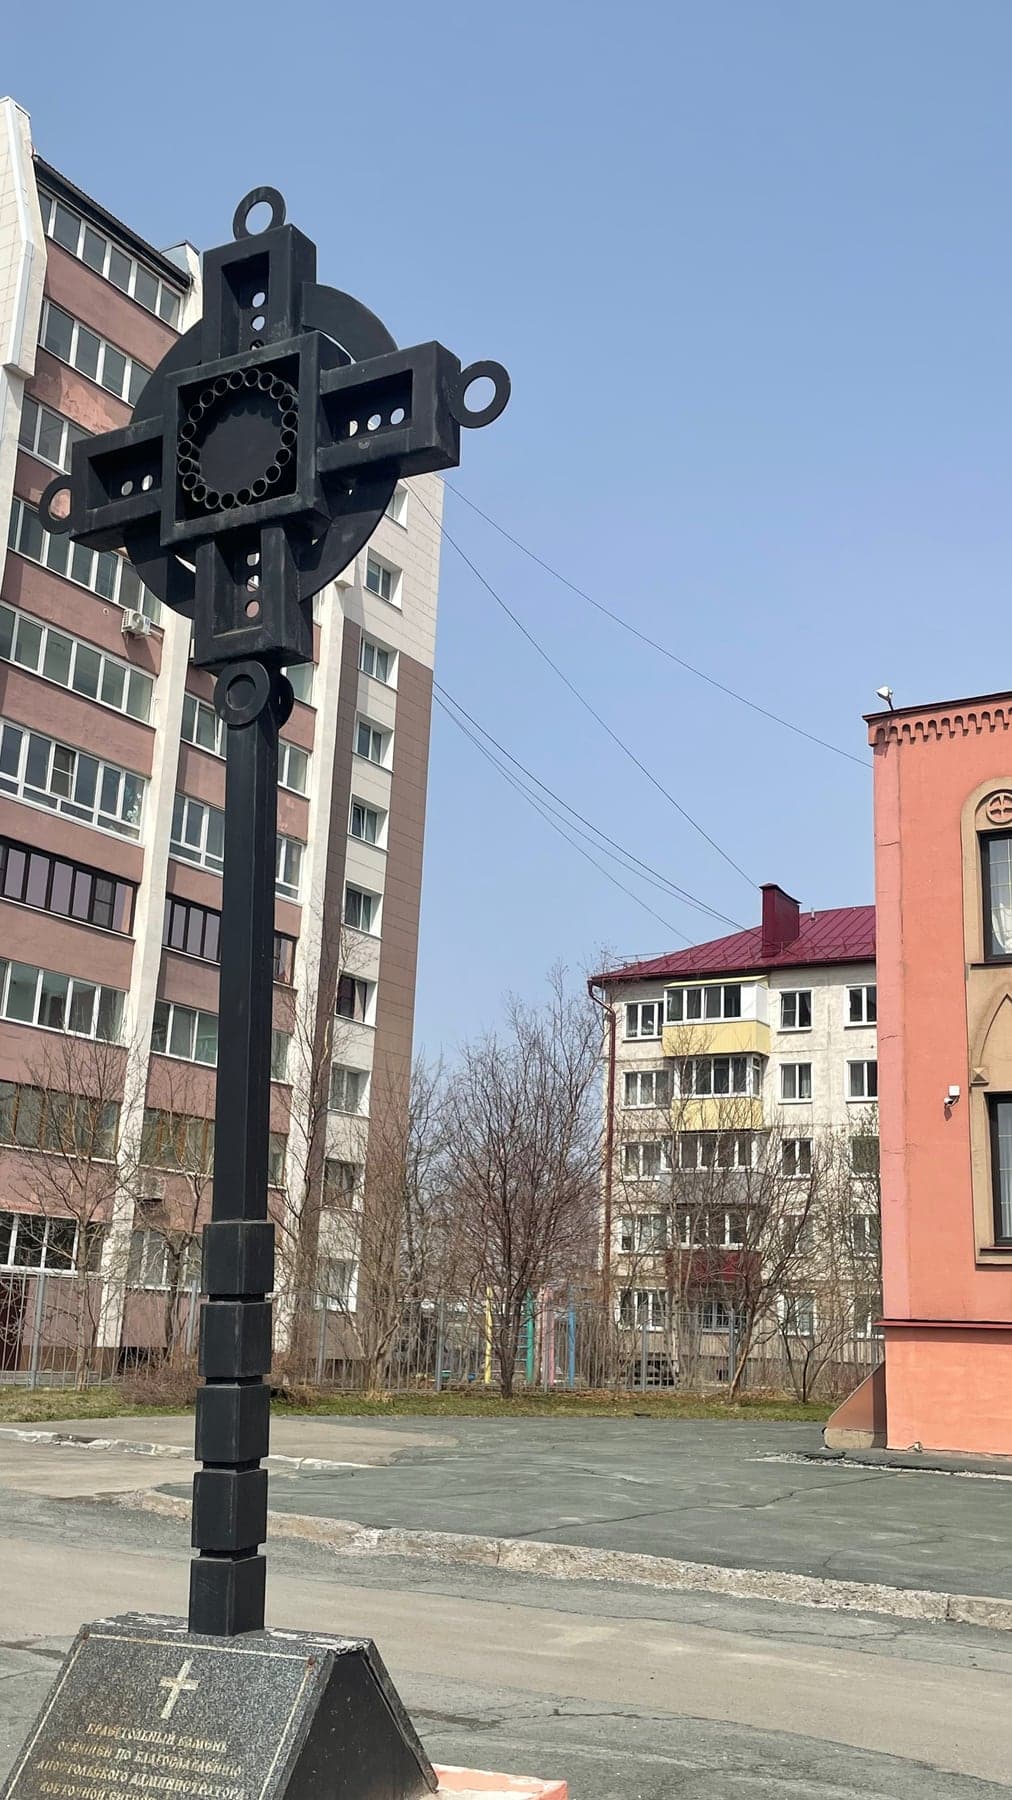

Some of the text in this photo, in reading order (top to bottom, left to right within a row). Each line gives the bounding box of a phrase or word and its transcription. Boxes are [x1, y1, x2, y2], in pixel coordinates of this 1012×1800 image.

[177, 1735, 228, 1753] КАМЕНЬ
[114, 1748, 132, 1761] ПО
[37, 1760, 129, 1782] АПОСТОЛЬСКОГО
